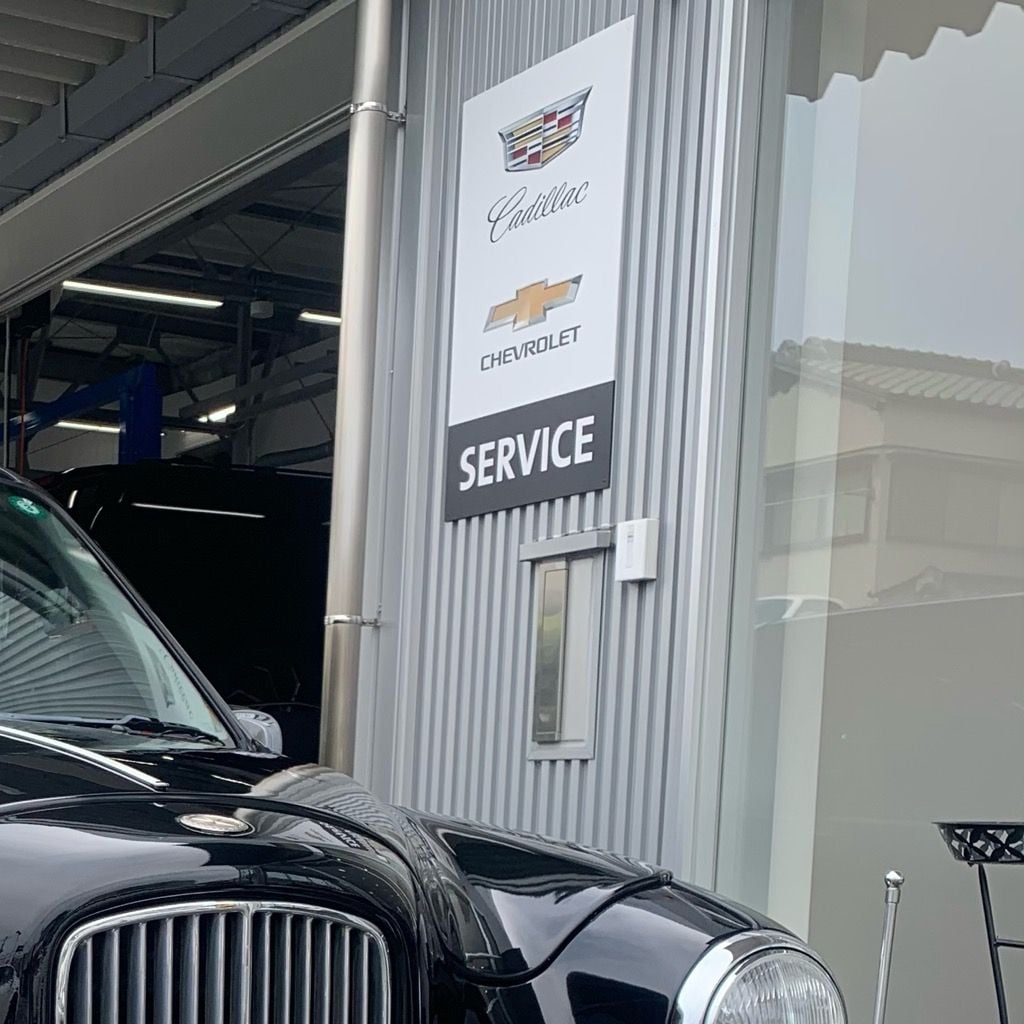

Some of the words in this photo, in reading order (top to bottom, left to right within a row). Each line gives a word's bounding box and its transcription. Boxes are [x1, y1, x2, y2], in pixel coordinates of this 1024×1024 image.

[487, 181, 589, 243] Cadillac
[480, 325, 581, 371] CHEVROLET
[459, 415, 595, 491] SERVICE
